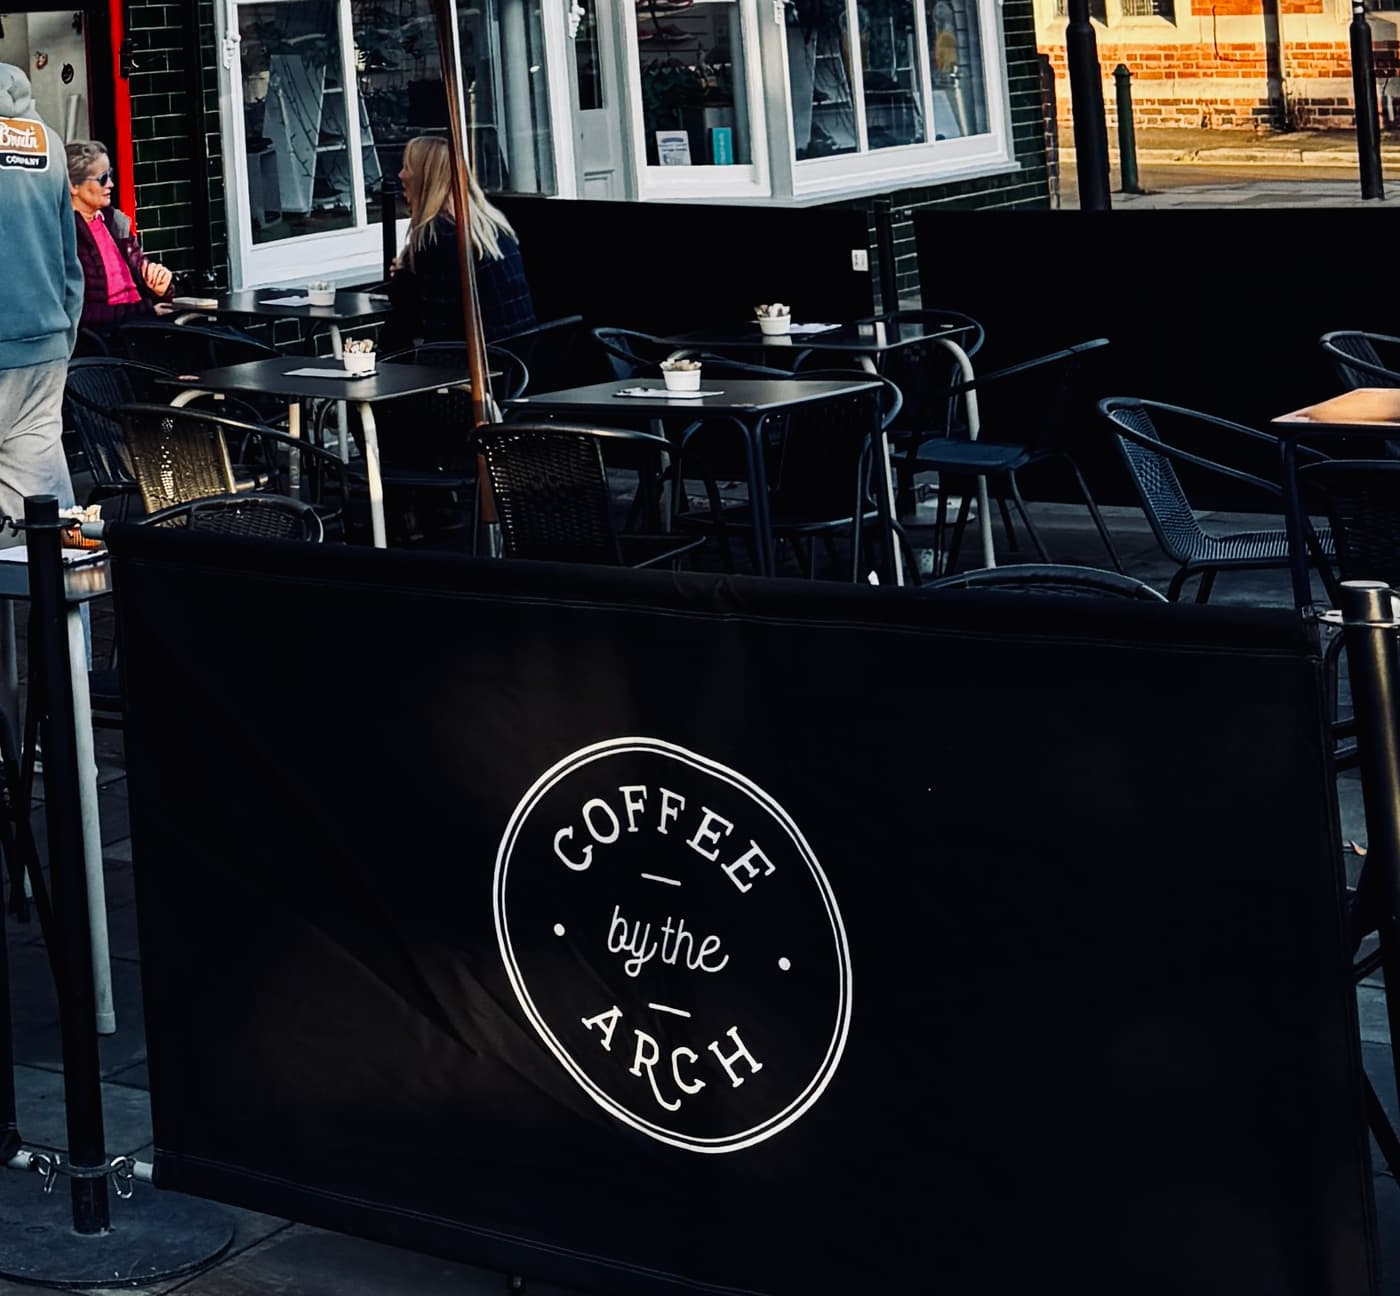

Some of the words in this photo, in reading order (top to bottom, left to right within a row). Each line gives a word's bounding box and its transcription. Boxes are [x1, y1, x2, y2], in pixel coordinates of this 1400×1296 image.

[553, 785, 776, 894] COFFEE
[607, 905, 657, 977] by
[660, 916, 729, 973] the
[581, 1005, 763, 1112] ARCH
